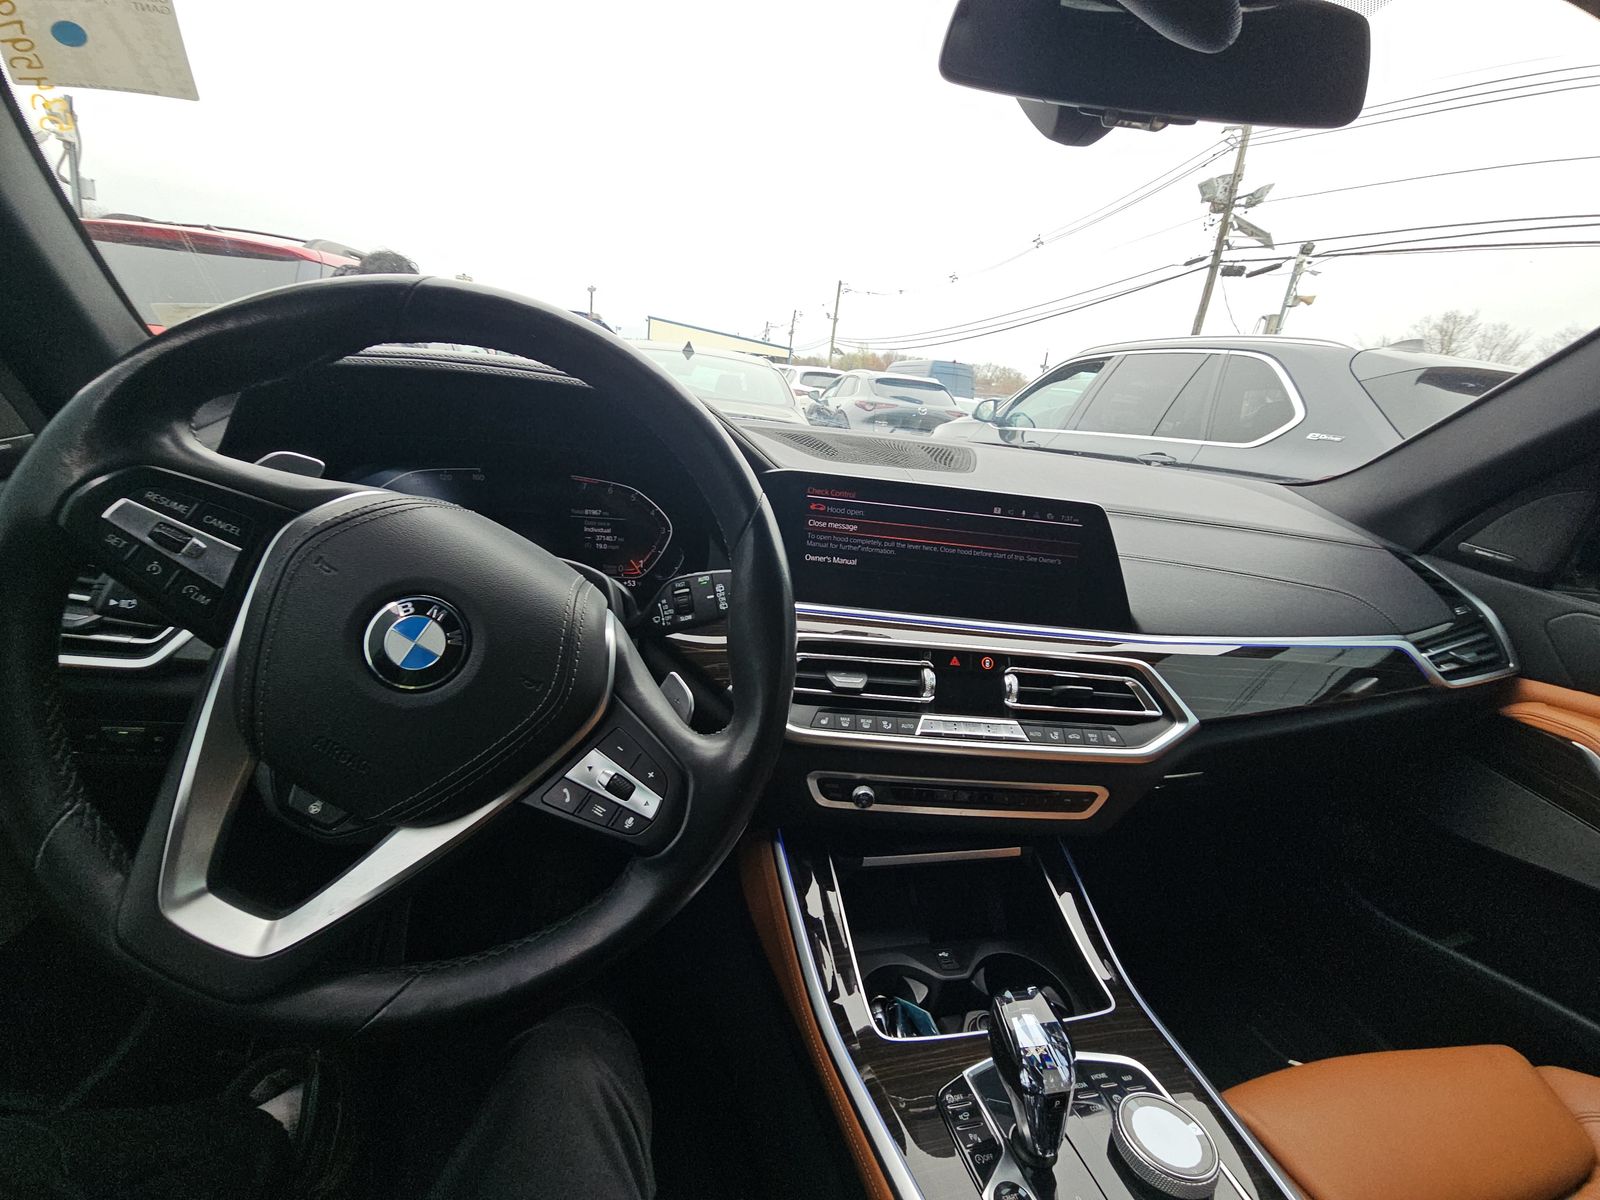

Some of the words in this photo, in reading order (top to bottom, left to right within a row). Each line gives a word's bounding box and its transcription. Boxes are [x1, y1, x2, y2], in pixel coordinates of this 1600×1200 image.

[808, 487, 830, 496] Check
[830, 489, 857, 498] Control
[144, 490, 190, 515] RESUME
[826, 506, 846, 514] Hood
[846, 508, 864, 517] open
[203, 515, 241, 537] CANCEL
[808, 518, 827, 529] Close
[827, 522, 858, 533] message
[105, 533, 128, 548] SET
[807, 540, 829, 548] Manual
[839, 543, 860, 551] further
[816, 534, 832, 542] open
[833, 535, 848, 543] hood
[883, 540, 895, 549] pull
[940, 545, 957, 554] Close
[957, 547, 973, 556] hood
[973, 548, 993, 557] before
[993, 551, 1007, 559] start
[1026, 554, 1038, 562] See
[804, 553, 832, 563] Owner's
[833, 556, 858, 566] Manual
[398, 601, 466, 646] BMW
